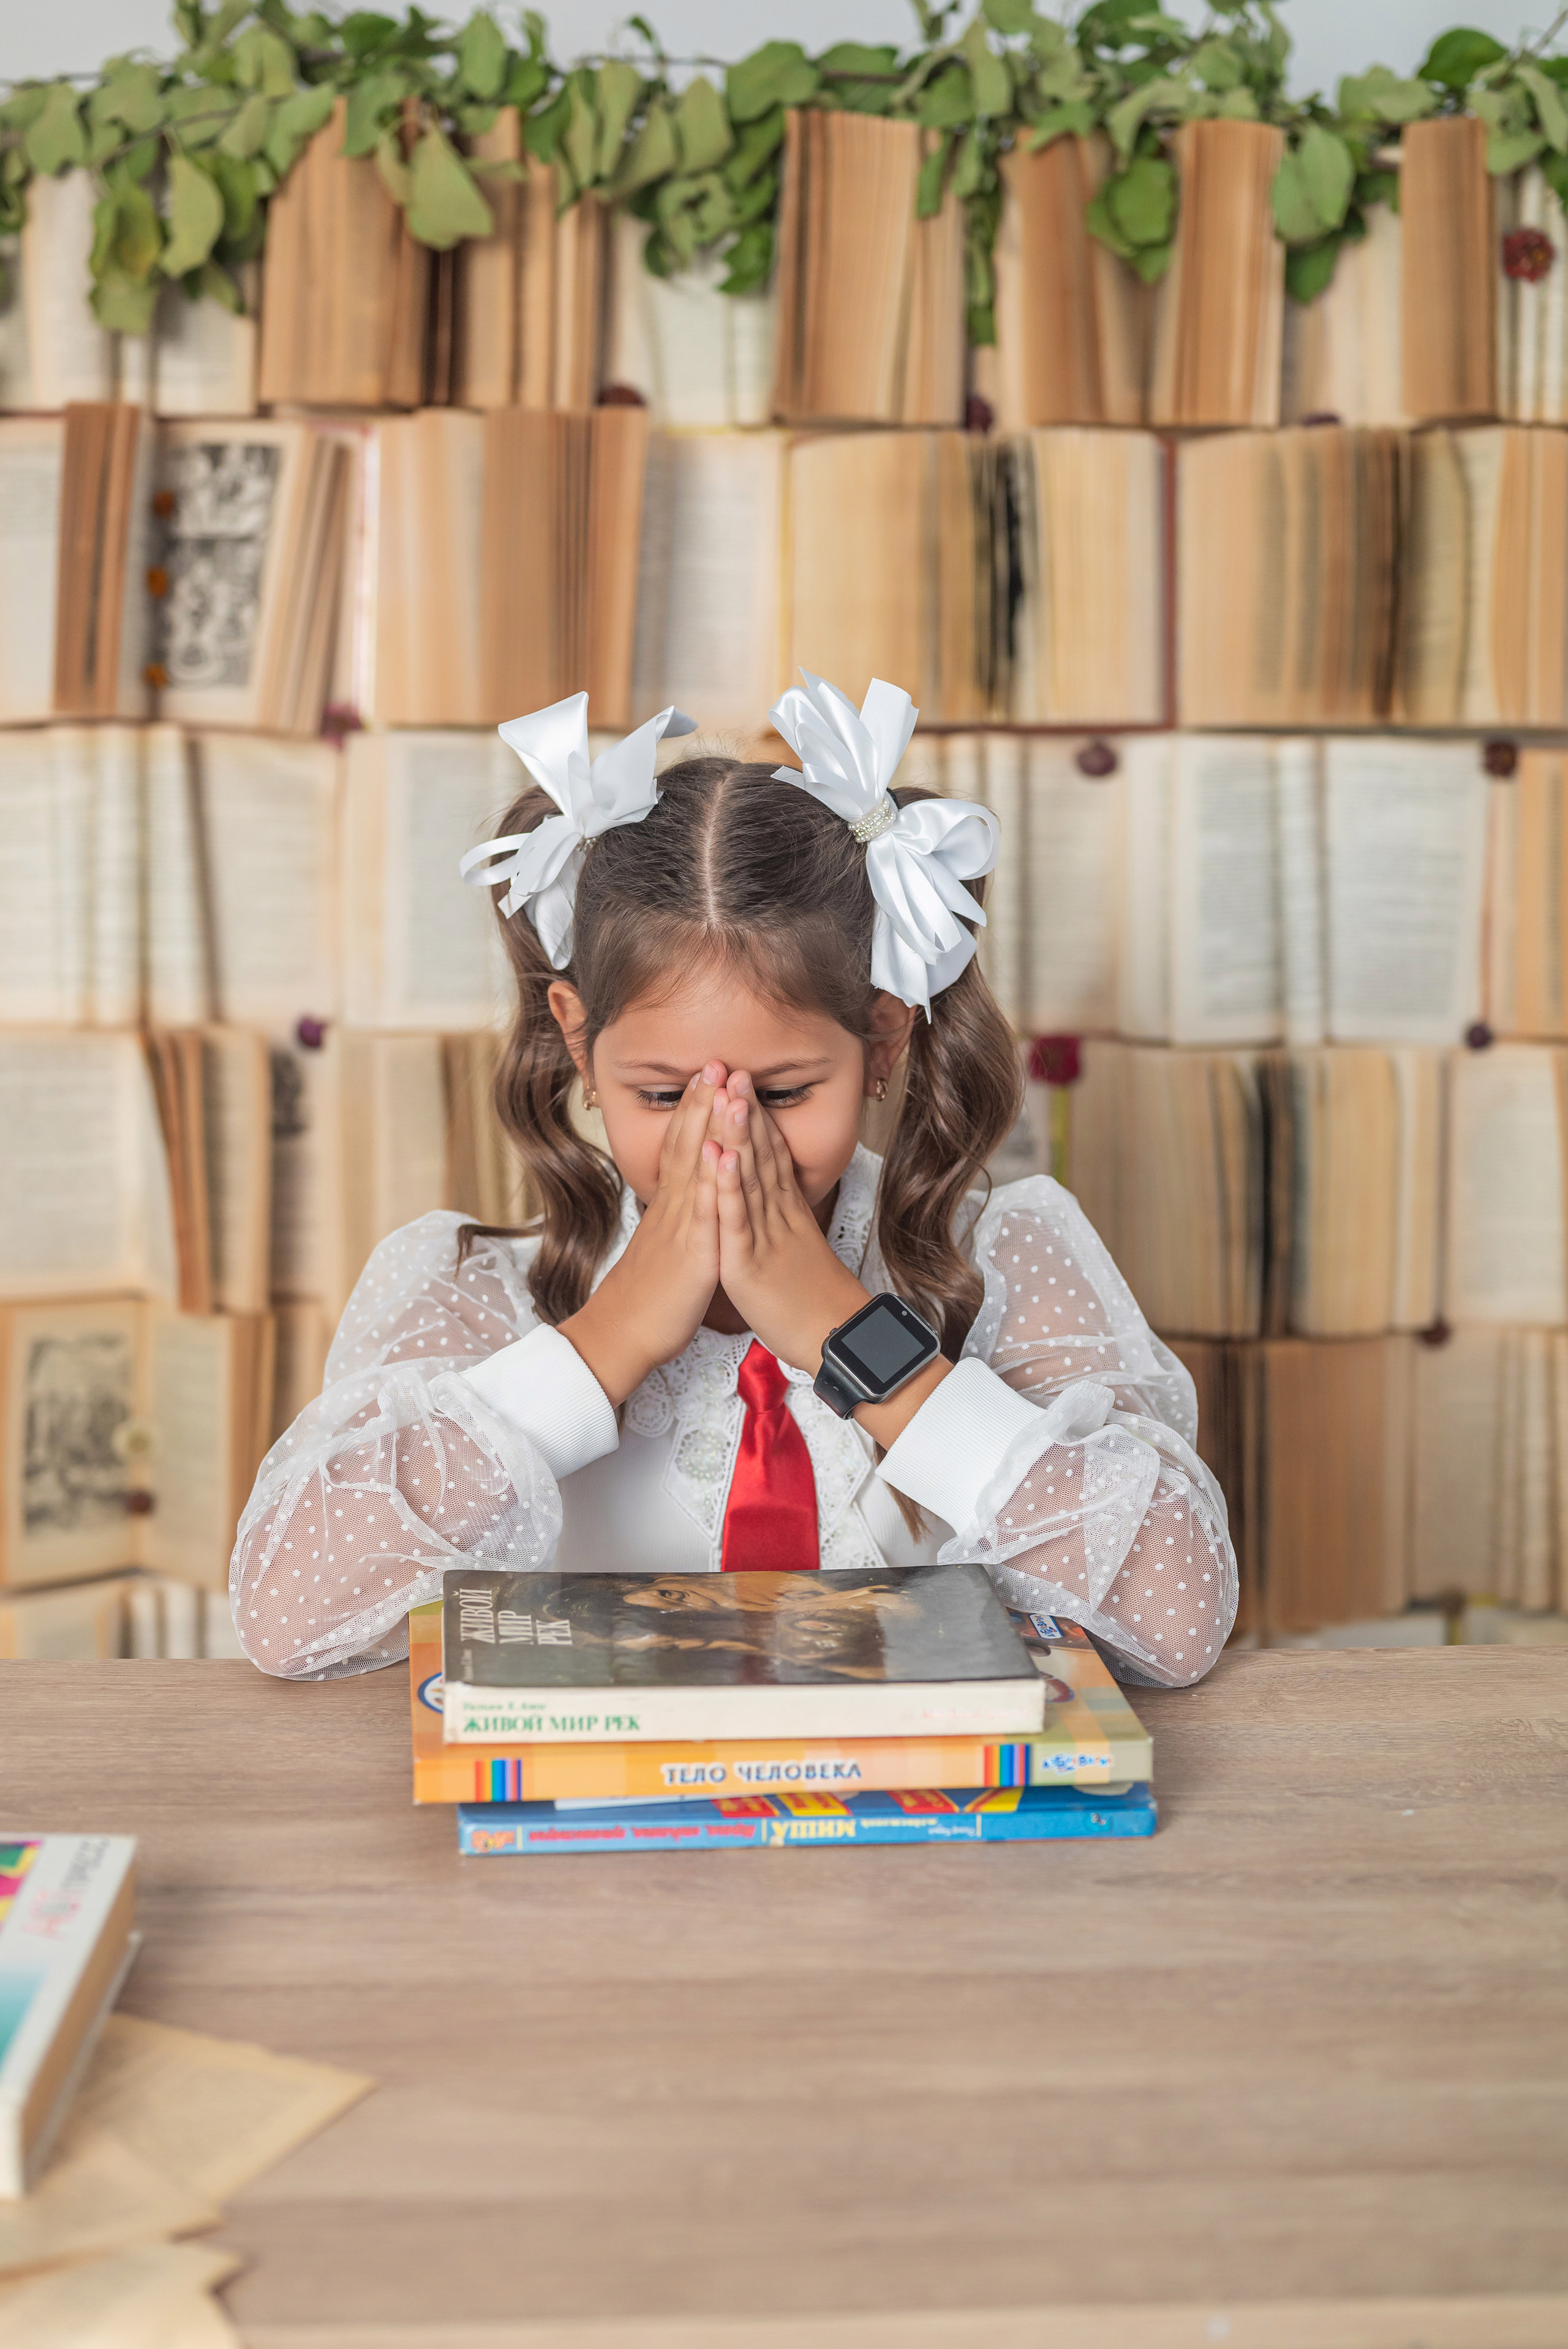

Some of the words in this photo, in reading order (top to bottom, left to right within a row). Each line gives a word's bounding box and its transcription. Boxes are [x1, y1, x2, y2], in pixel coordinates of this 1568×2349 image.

[453, 1588, 496, 1644] ЖИВОЙ
[498, 1610, 534, 1644] МИР
[535, 1619, 573, 1646] РЕК
[463, 1714, 543, 1733] ЖИВОЙ
[550, 1715, 598, 1731] МИР
[604, 1715, 640, 1731] РЕК
[664, 1763, 727, 1785] ТЕЛО
[736, 1760, 862, 1782] ЧЕЛОВЕКА
